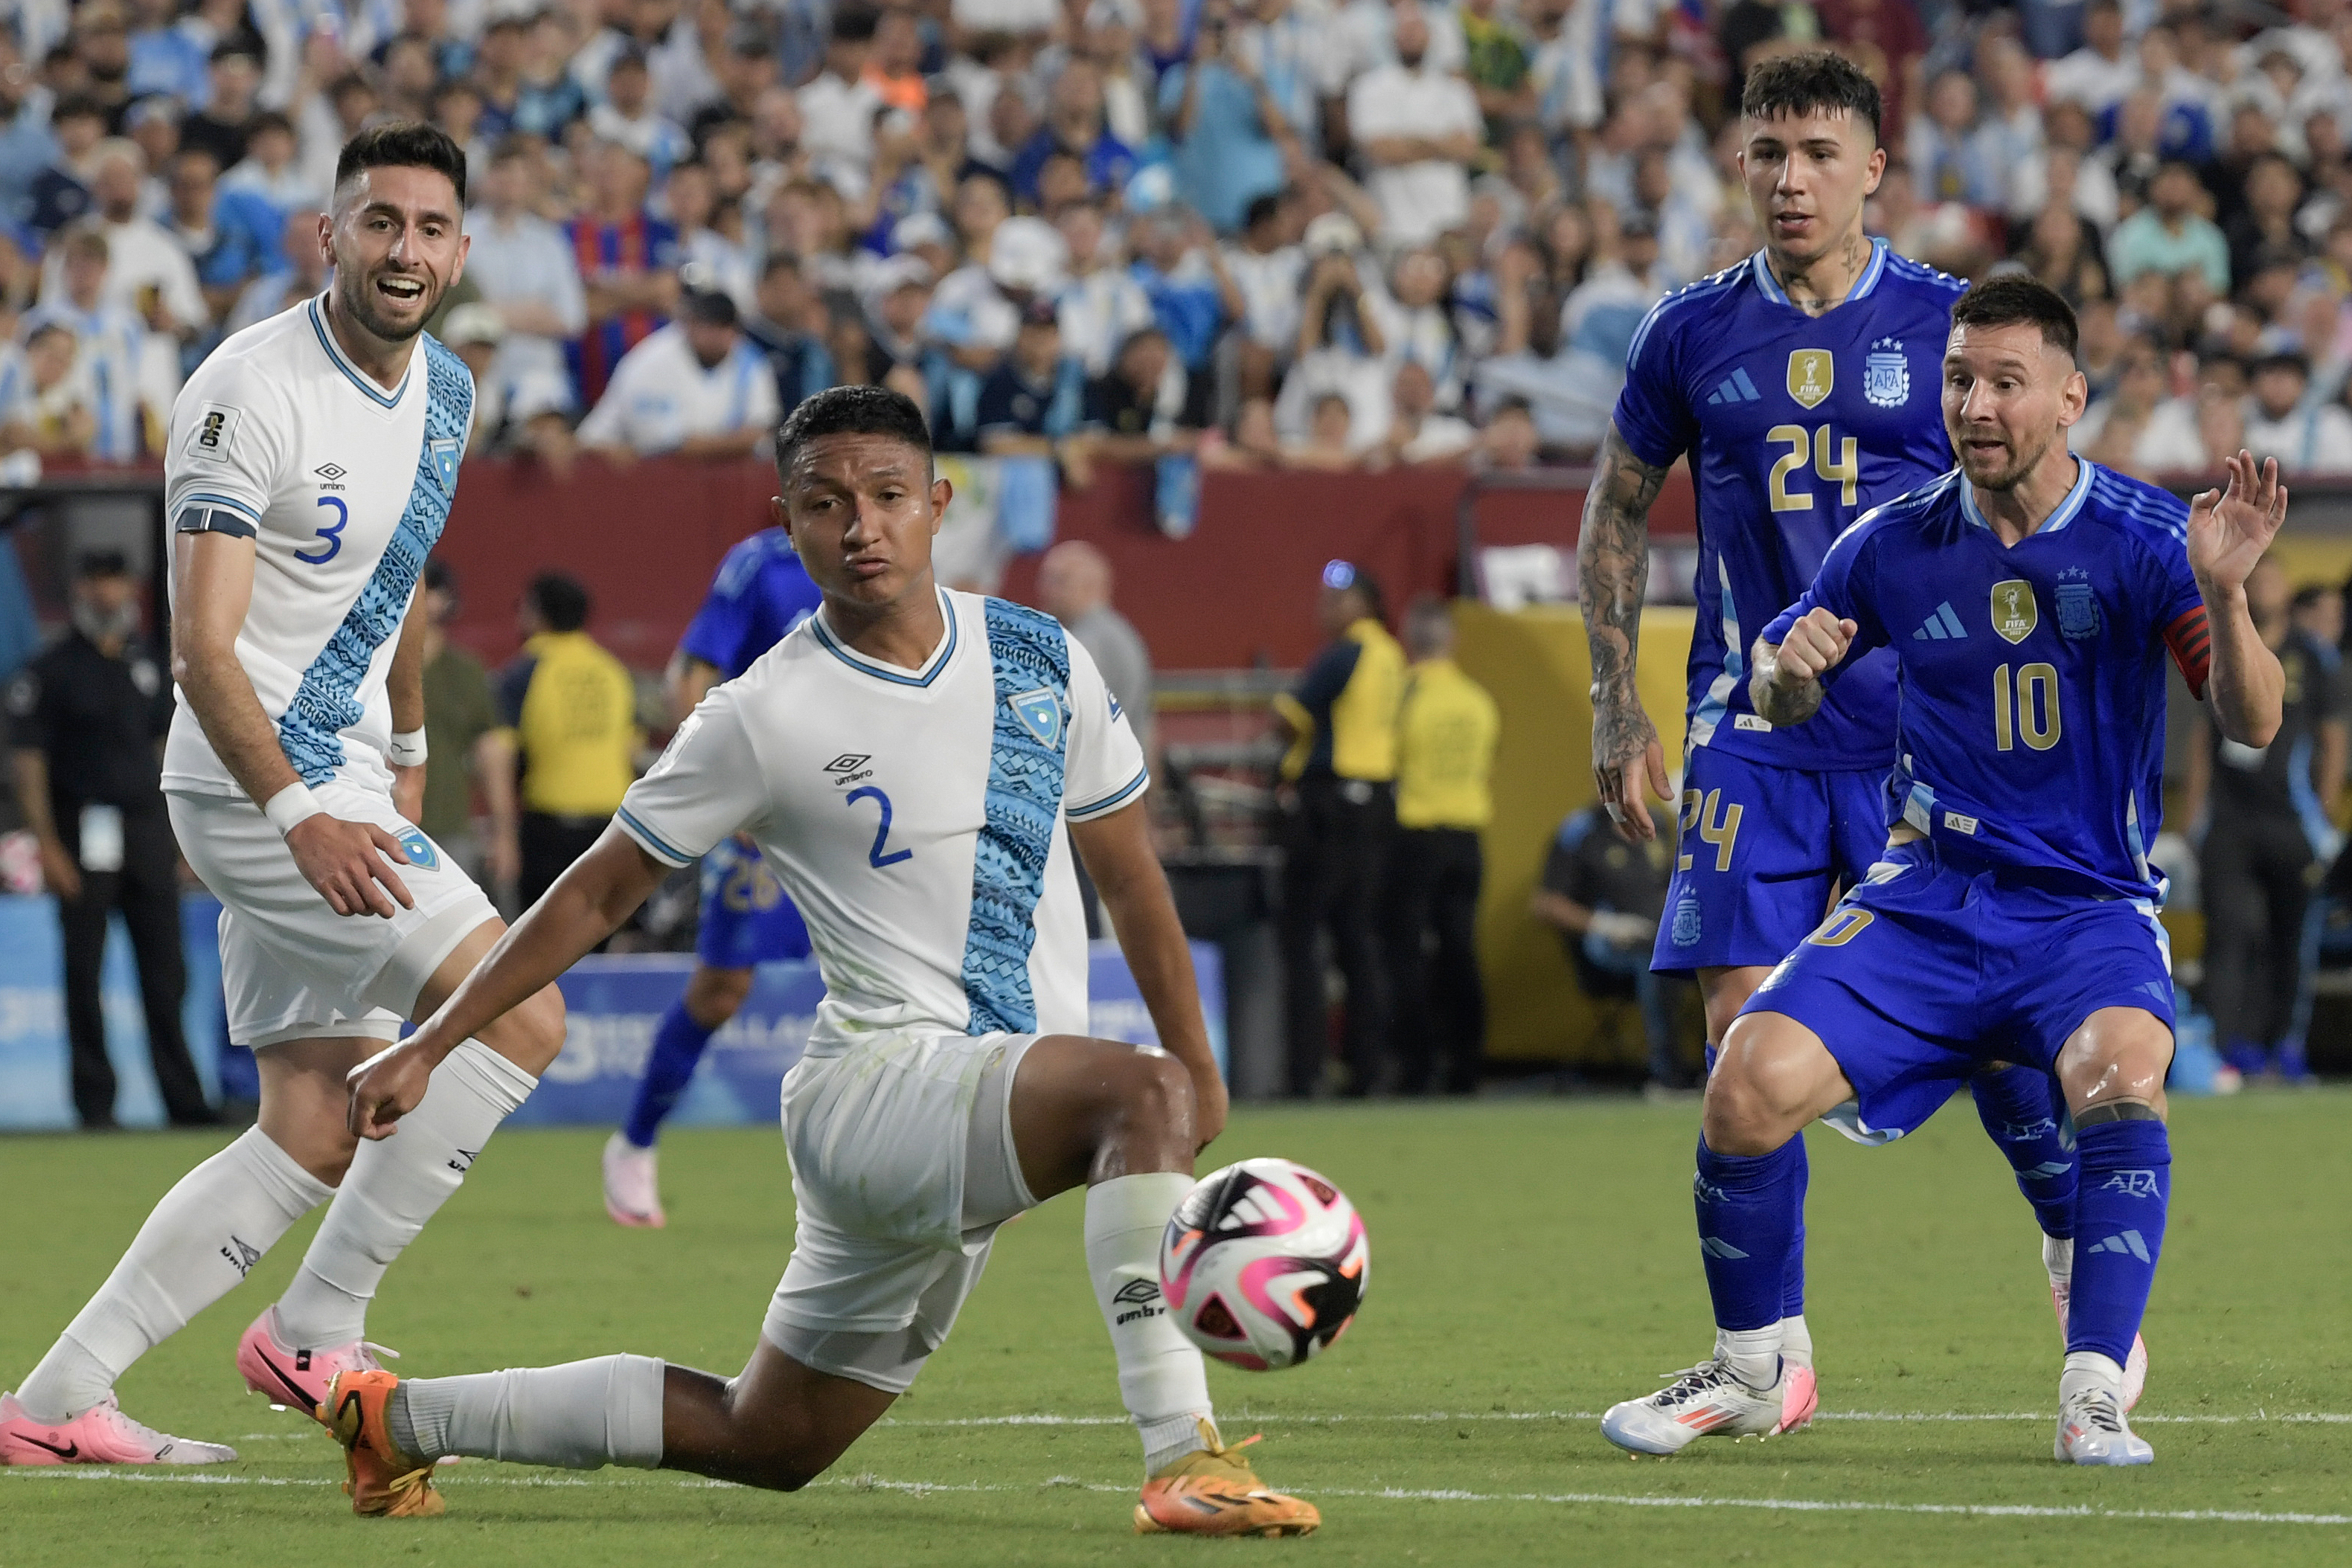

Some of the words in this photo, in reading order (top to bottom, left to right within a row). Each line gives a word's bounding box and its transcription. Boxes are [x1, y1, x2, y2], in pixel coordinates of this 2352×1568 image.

[1800, 384, 1821, 393] FIFA
[1874, 367, 1900, 391] AFA
[1766, 423, 1858, 513] 24
[320, 481, 345, 491] umbro
[293, 496, 348, 565] 3
[2005, 619, 2026, 629] FIFA
[1993, 662, 2062, 751] 10
[835, 769, 873, 786] umbro
[845, 785, 913, 869] 2
[1678, 788, 1744, 873] 24
[1807, 907, 1875, 947] 0
[2100, 1169, 2162, 1198] AFA
[1117, 1305, 1165, 1326] umbr
